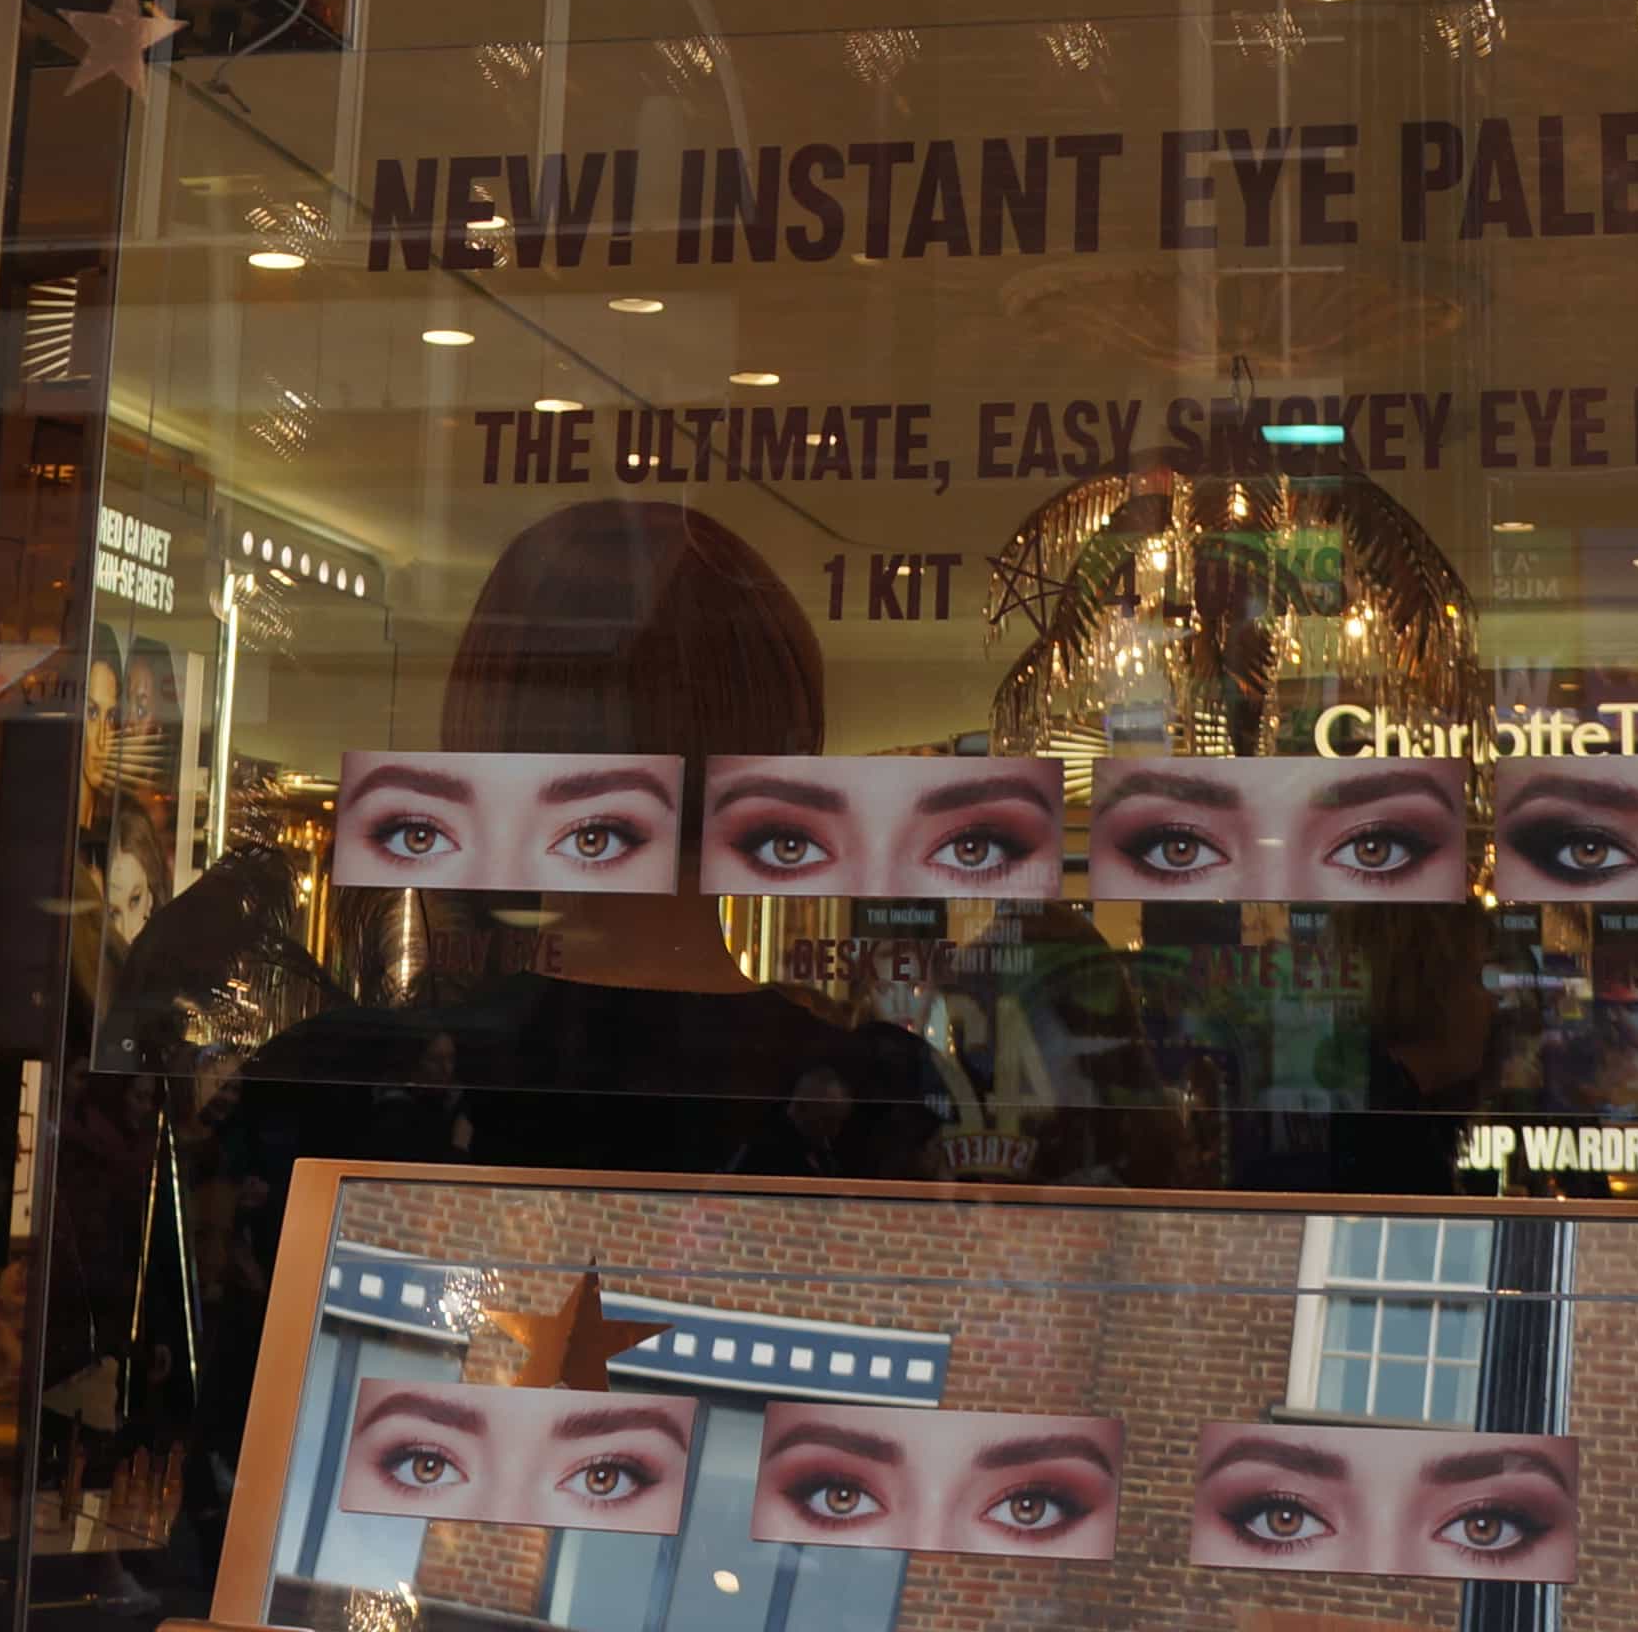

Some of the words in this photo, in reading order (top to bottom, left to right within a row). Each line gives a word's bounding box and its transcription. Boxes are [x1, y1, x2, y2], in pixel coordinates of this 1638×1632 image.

[366, 150, 637, 272] NEW!
[675, 134, 1122, 264] INSTANT
[1161, 125, 1359, 250] EYE
[475, 411, 593, 486] THE
[616, 404, 951, 494] ULTIMATE,
[978, 399, 1143, 480] EASY
[1166, 392, 1453, 476] SMOKEY
[1480, 386, 1609, 468] EYE
[99, 505, 123, 550] RED
[124, 515, 171, 569] CARPET
[120, 557, 176, 614] SECRETS
[823, 554, 845, 622] 1
[868, 554, 963, 622] KIT
[1601, 914, 1619, 930] THE
[792, 938, 878, 982] DESK
[891, 939, 957, 982] EYE
[1457, 1125, 1516, 1171] UP
